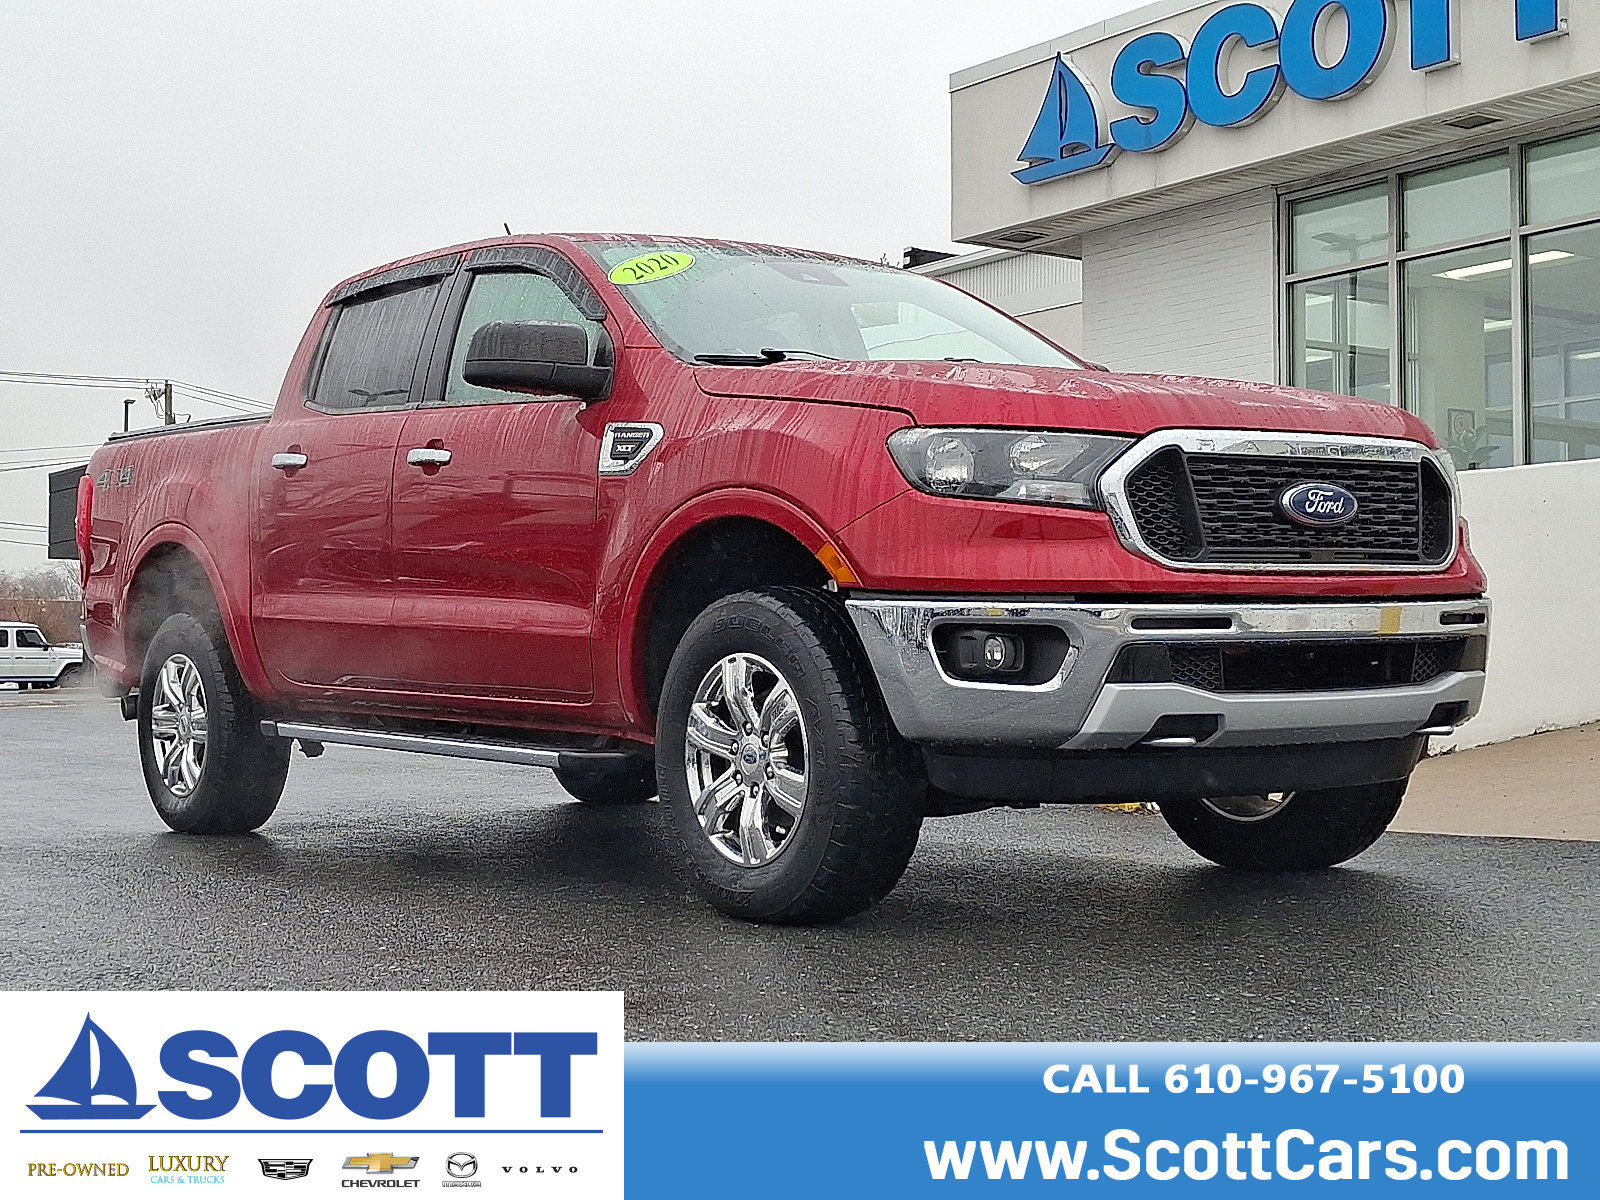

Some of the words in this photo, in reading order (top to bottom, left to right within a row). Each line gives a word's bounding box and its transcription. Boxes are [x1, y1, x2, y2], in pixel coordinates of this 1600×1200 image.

[622, 253, 679, 280] 2020
[615, 444, 636, 452] XLT
[1305, 489, 1345, 514] Ford
